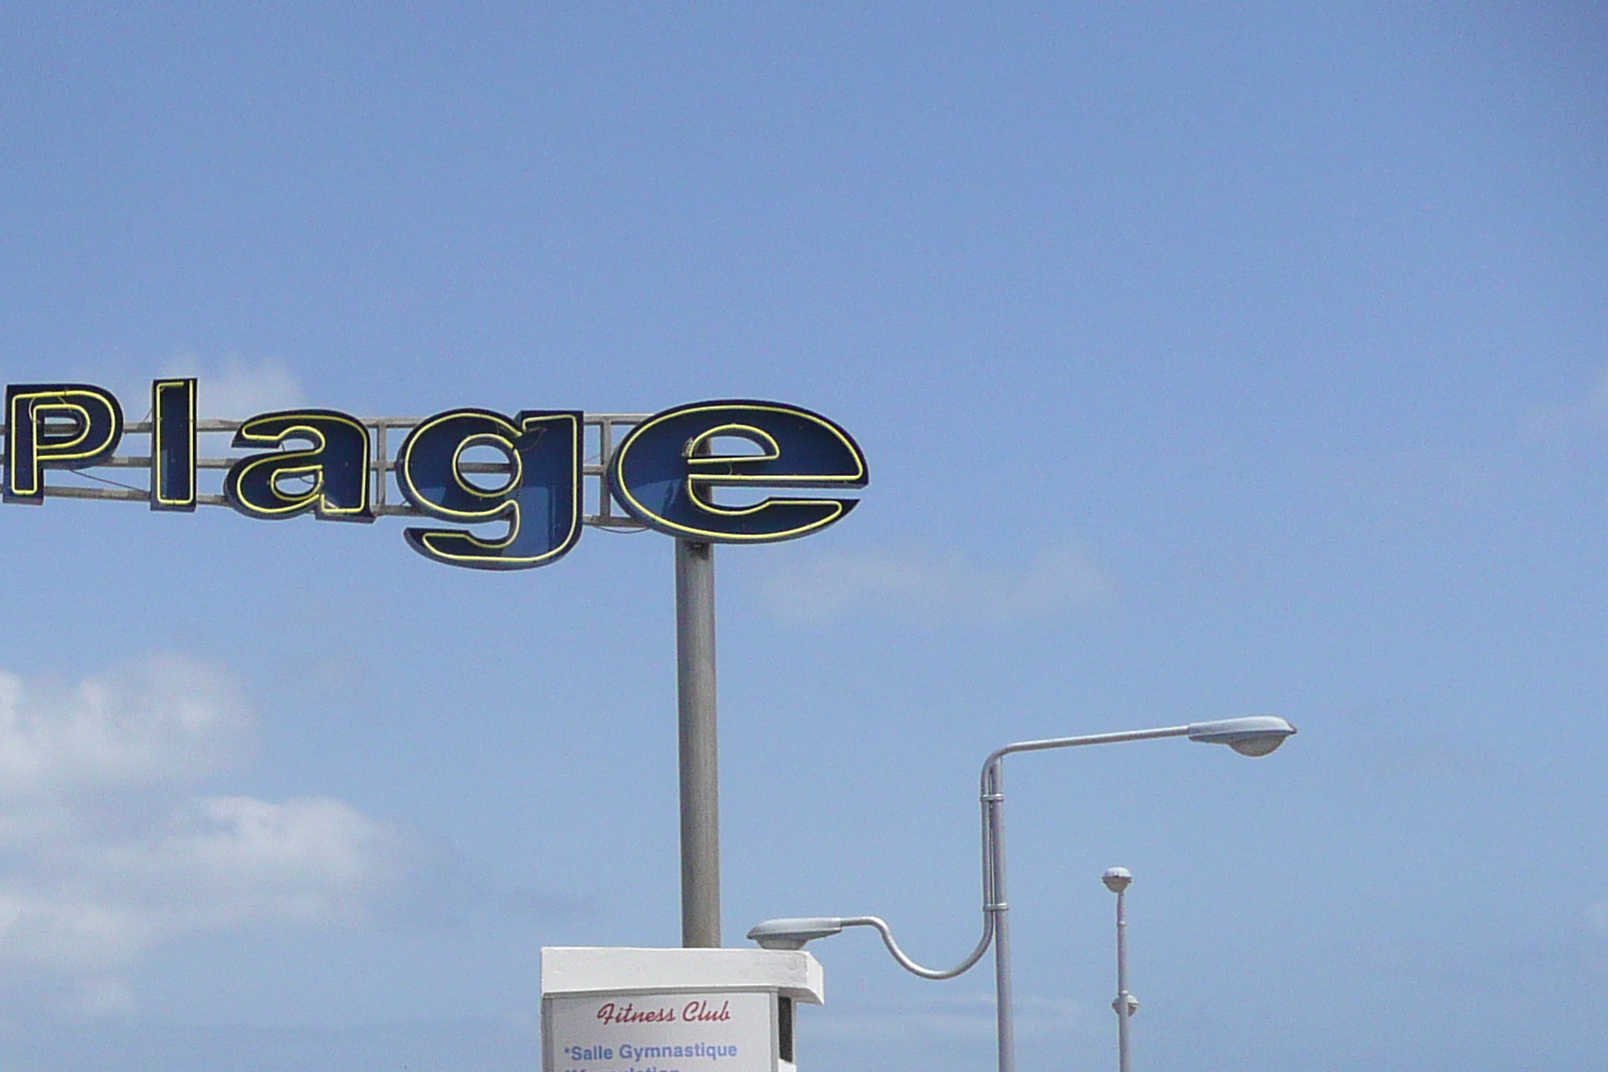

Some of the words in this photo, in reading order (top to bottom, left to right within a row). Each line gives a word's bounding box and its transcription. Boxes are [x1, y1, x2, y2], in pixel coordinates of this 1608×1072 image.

[3, 377, 870, 571] Plage
[597, 1002, 676, 1025] Fitness
[682, 1000, 730, 1022] Club
[571, 1045, 613, 1061] Salle
[619, 1042, 737, 1063] Gymnastique
